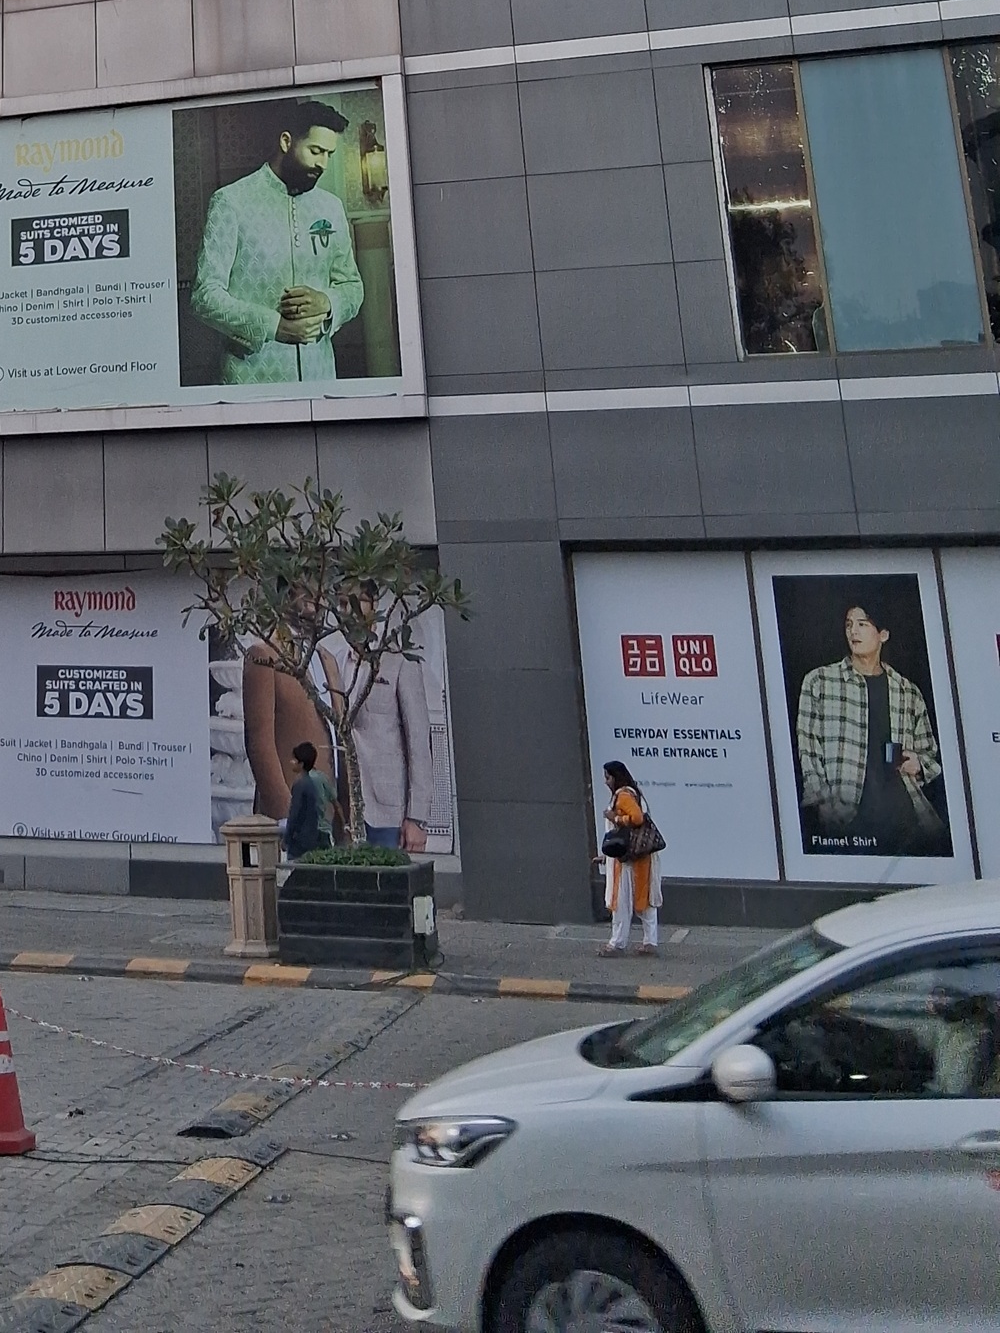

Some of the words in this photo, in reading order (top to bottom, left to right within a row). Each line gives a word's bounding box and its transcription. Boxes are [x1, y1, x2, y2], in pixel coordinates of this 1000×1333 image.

[15, 129, 124, 173] Raymond
[48, 175, 68, 196] to
[69, 177, 154, 196] Measure
[32, 214, 103, 229] CUSTOMIZED
[20, 229, 51, 241] SUITS
[53, 224, 104, 238] CRAFTED
[106, 223, 118, 233] IN
[18, 241, 36, 264] 5
[44, 233, 121, 262] DAYS
[0, 290, 28, 300] Jacket
[36, 286, 84, 298] Bandhgala
[95, 283, 121, 292] Bundi
[130, 281, 165, 291] Trouser
[26, 302, 55, 311] Denim
[63, 299, 84, 308] Shirt
[93, 297, 113, 306] Polo
[116, 295, 147, 304] T-Shirt
[11, 316, 24, 325] 3D
[26, 313, 77, 324] customized
[80, 310, 133, 320] accessories
[7, 367, 27, 378] Visit
[30, 369, 41, 377] us
[44, 366, 53, 376] at
[56, 365, 87, 375] Lower
[89, 362, 128, 373] Ground
[130, 361, 157, 372] Floor
[54, 586, 136, 617] Raymond
[31, 620, 73, 639] Made
[79, 620, 94, 638] to
[94, 625, 158, 639] Measure
[677, 640, 708, 655] UNI
[679, 657, 713, 674] QLO
[58, 669, 127, 679] CUSTOMIZED
[45, 680, 76, 690] SUITS
[79, 680, 128, 691] CRAFTED
[130, 681, 143, 691] IN
[44, 691, 60, 715] 5
[69, 691, 144, 717] DAYS
[641, 692, 704, 705] LifeWear
[614, 728, 668, 739] EVERYDAY
[673, 729, 741, 740] ESSENTIALS
[0, 738, 16, 747] Suit
[24, 739, 52, 748] Jacket
[60, 740, 108, 751] Bandhgala
[118, 741, 144, 751] Bundi
[152, 742, 187, 752] Trouser
[631, 747, 659, 757] NEAR
[663, 747, 718, 758] ENTRANCE
[17, 753, 42, 762] Chino
[50, 754, 78, 763] Denim
[86, 755, 107, 764] Shirt
[116, 756, 136, 765] Polo
[138, 757, 168, 767] T-Shirt
[35, 768, 47, 777] 3D
[50, 768, 100, 778] customized
[103, 771, 155, 780] accessories
[31, 827, 50, 837] Visit
[53, 830, 65, 838] us
[68, 829, 77, 839] at
[80, 828, 109, 840] Lower
[112, 830, 149, 842] Ground
[812, 836, 849, 846] Flannel
[853, 836, 877, 846] Shirt
